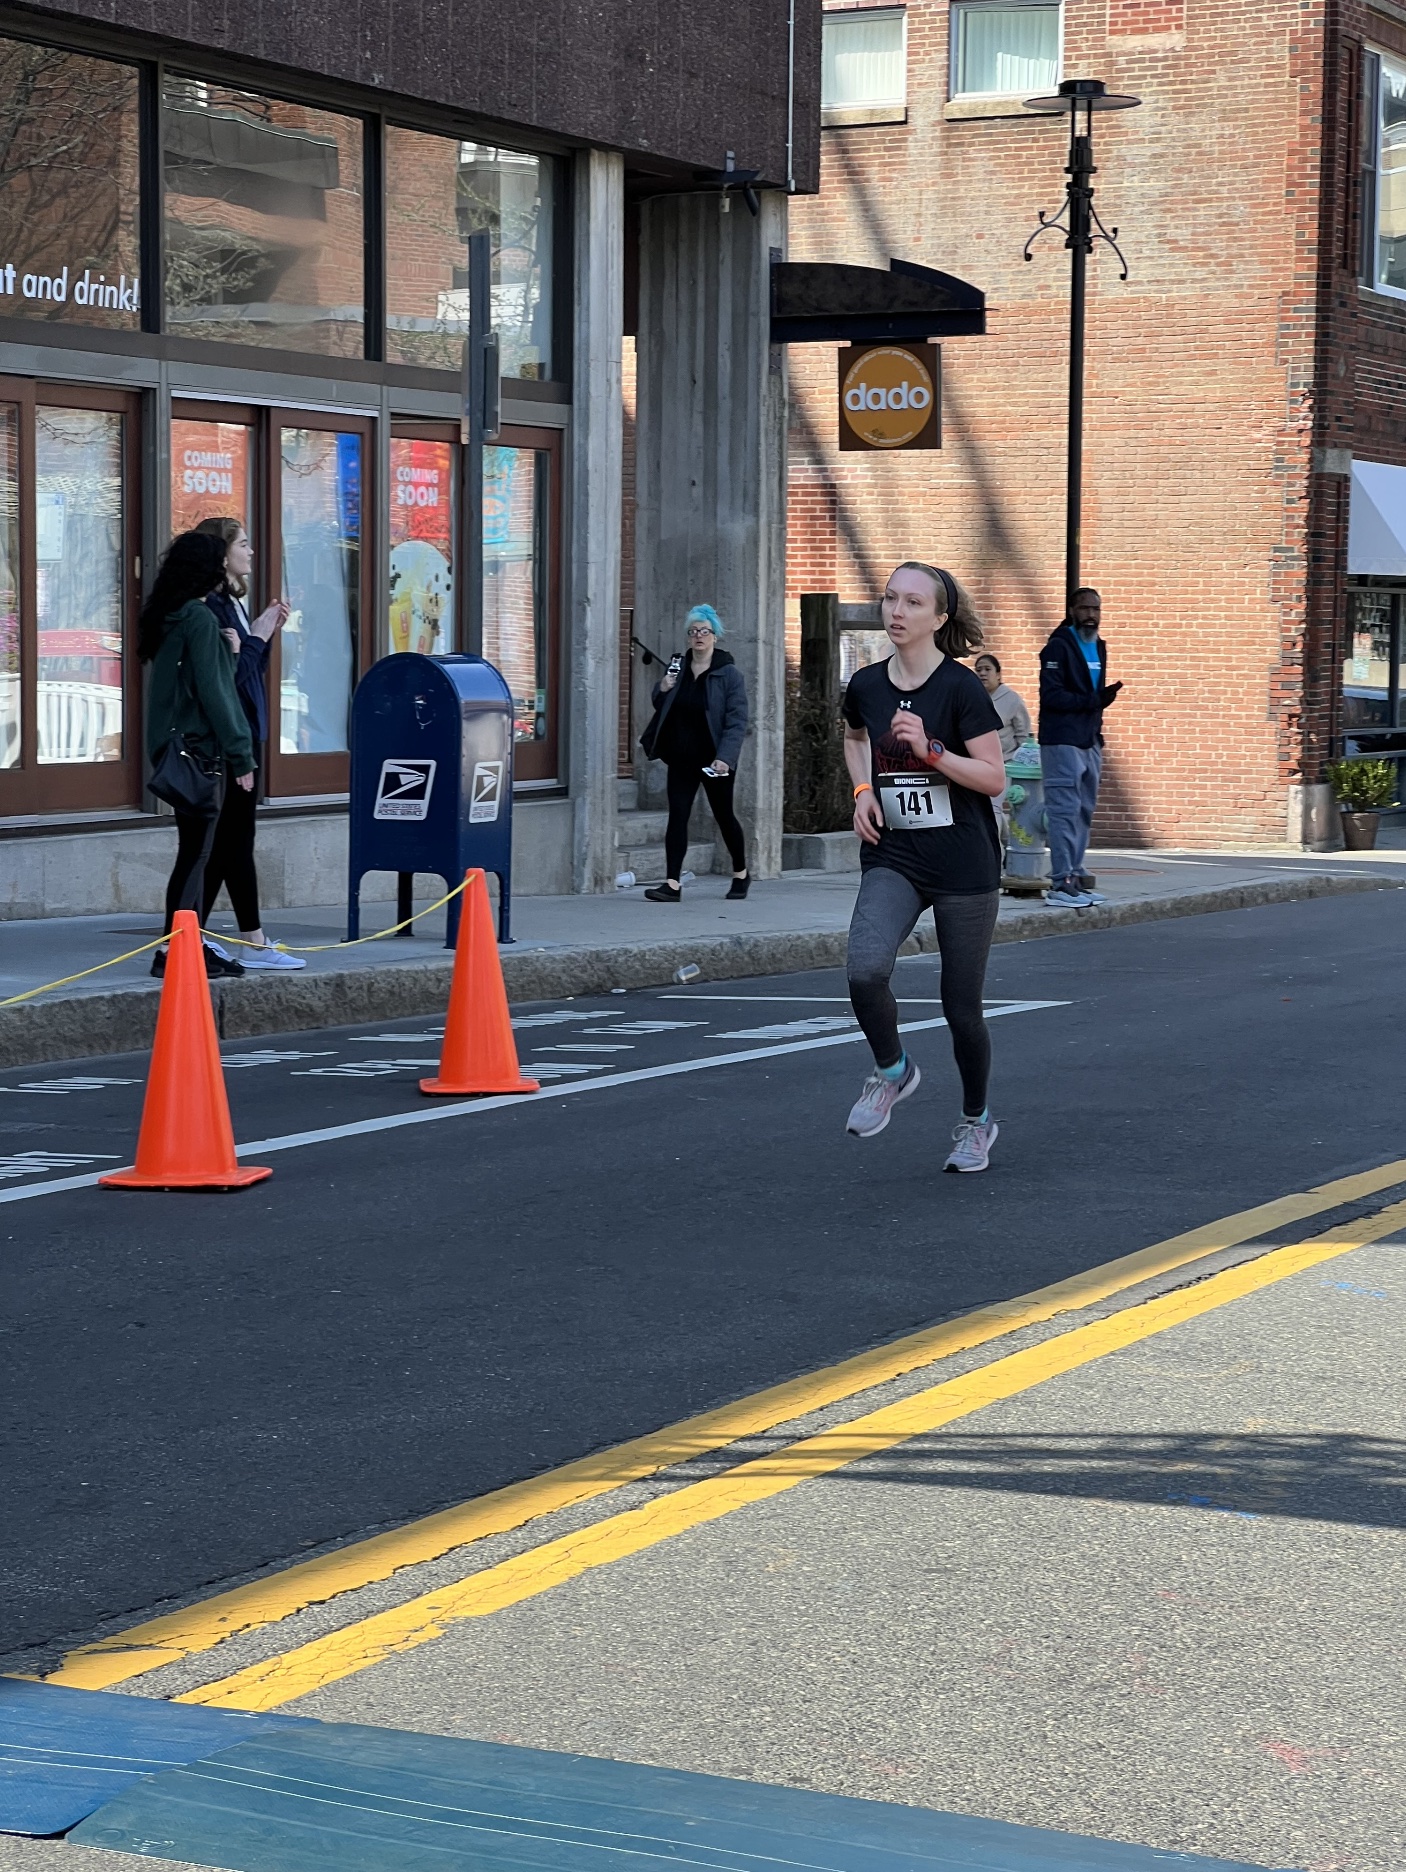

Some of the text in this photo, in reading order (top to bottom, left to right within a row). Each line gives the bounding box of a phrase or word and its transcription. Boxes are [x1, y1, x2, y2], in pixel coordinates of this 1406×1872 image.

[0, 263, 139, 312] t and drink!
[844, 381, 931, 411] dado
[183, 450, 233, 469] COMING
[183, 469, 233, 495] SOON
[396, 466, 439, 483] COMING
[396, 485, 439, 507] SOON
[896, 790, 934, 816] 141
